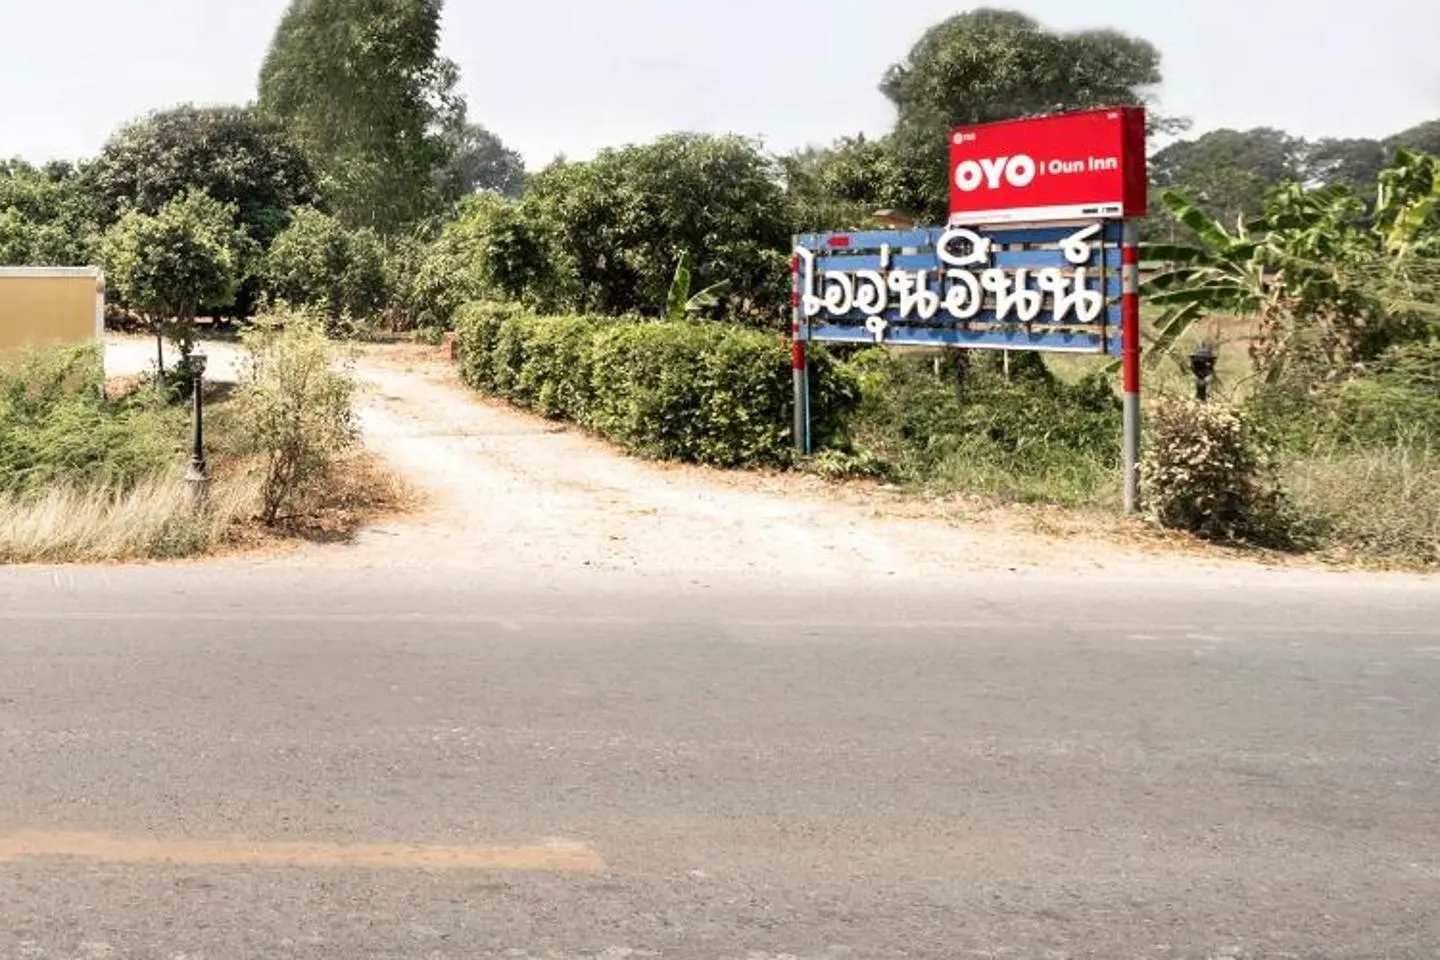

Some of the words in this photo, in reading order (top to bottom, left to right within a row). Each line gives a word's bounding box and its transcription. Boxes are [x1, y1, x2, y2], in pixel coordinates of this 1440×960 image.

[955, 154, 1036, 192] OYO
[1048, 159, 1084, 174] Oun
[1088, 155, 1118, 172] Inn
